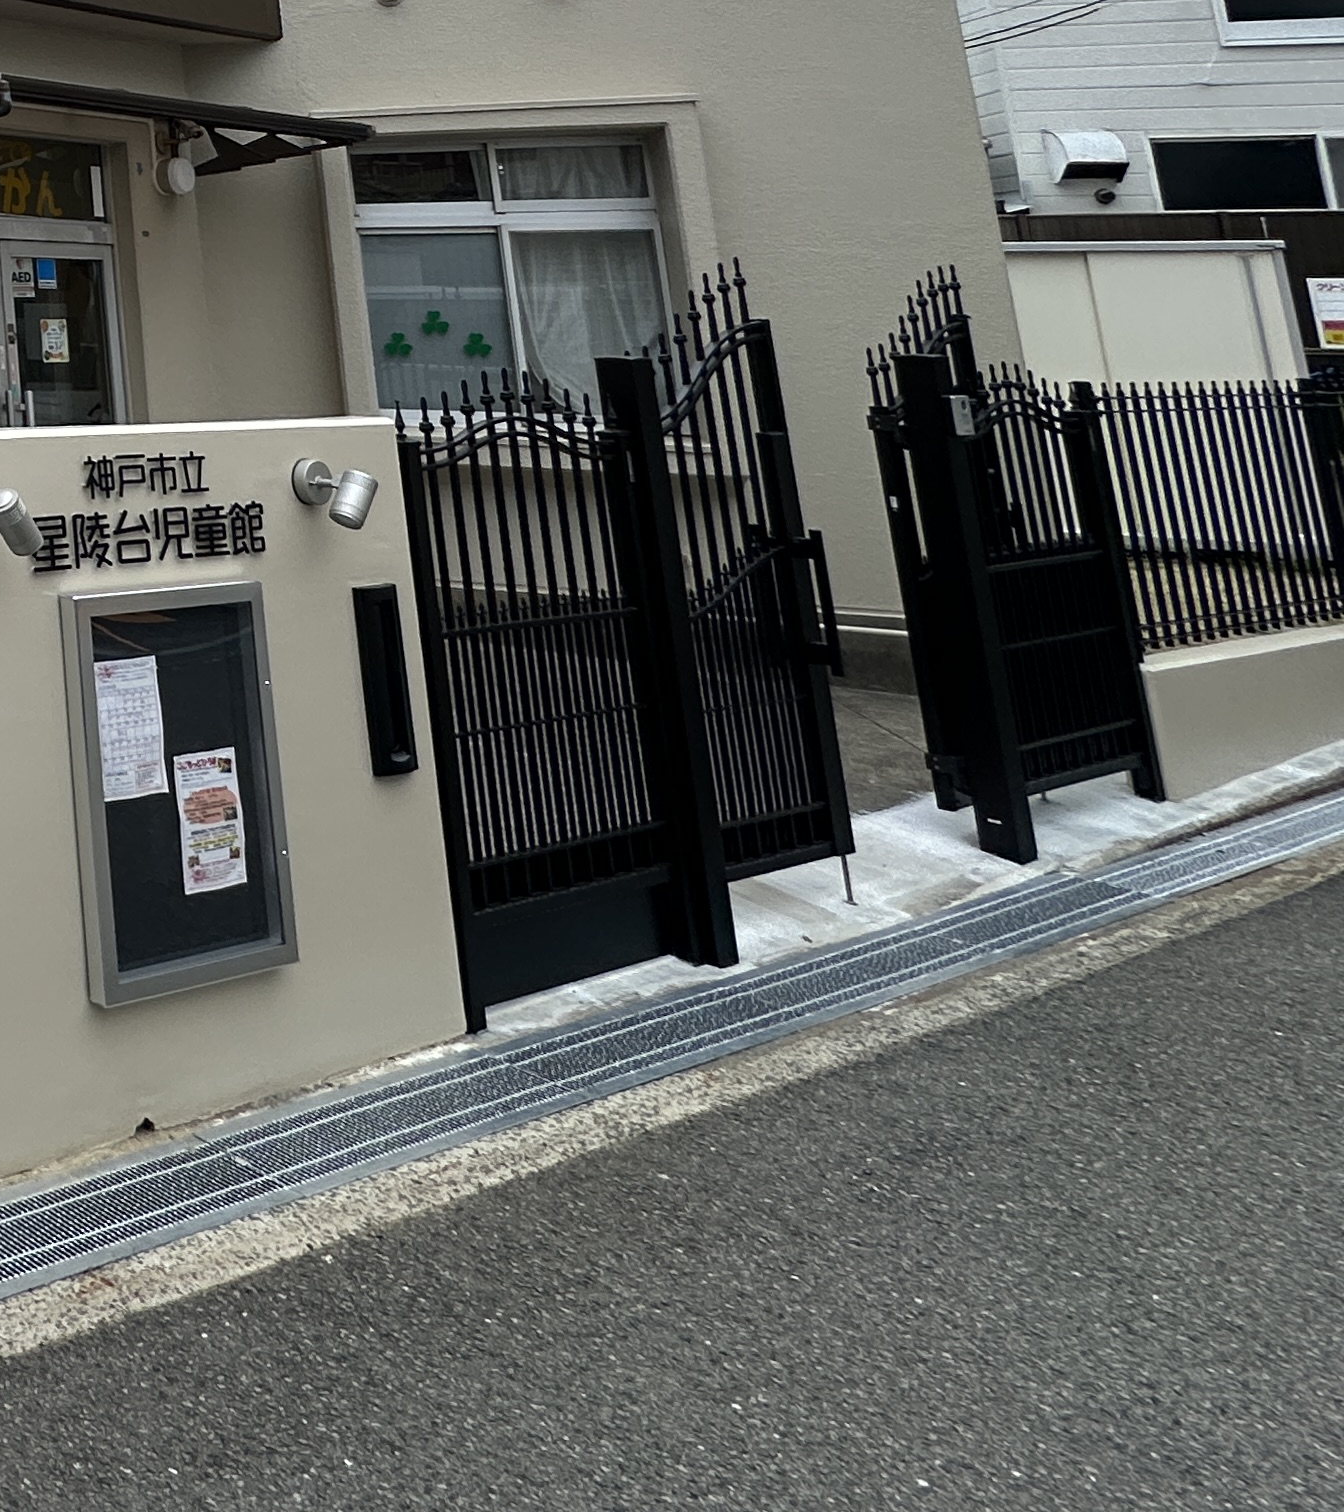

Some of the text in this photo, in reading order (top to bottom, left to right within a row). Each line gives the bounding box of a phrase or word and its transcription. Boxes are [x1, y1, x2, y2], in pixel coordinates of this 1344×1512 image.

[12, 272, 31, 282] AED
[82, 451, 209, 499] 神戸市立
[32, 501, 265, 572] 星陵台児童館
